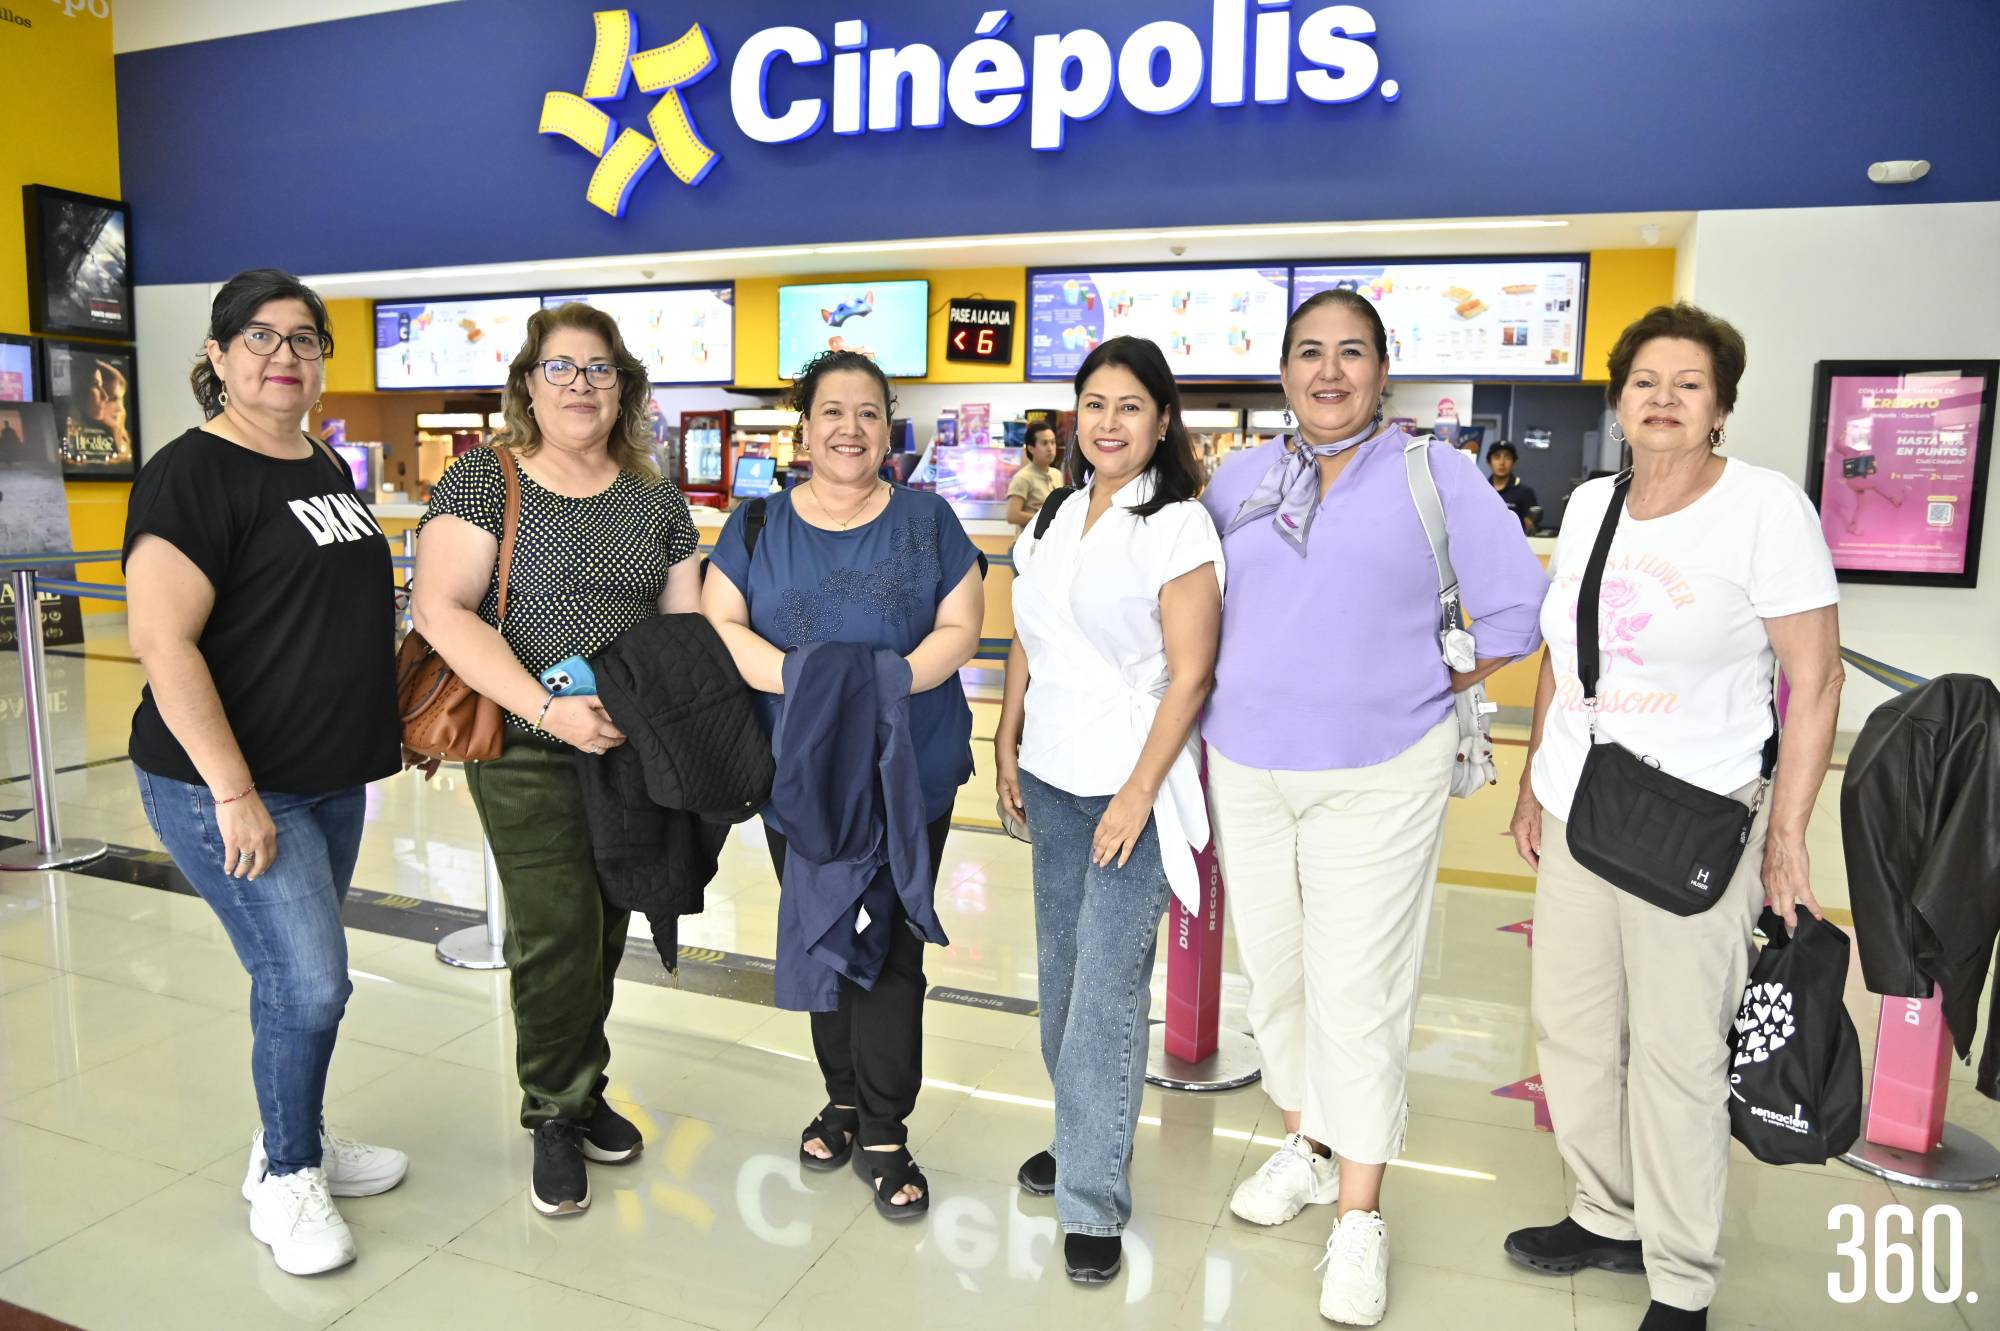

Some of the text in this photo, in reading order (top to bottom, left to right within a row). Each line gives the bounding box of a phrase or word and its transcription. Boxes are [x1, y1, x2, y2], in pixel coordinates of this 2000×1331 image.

[0, 8, 32, 28] llos
[950, 308, 1010, 325] PASE A LA CAJA
[977, 329, 993, 354] 6
[1896, 436, 1937, 446] HASTA
[1896, 447, 1967, 457] EN PUNTOS
[288, 494, 383, 547] DKNY
[1634, 554, 1697, 610] FLOWER
[1556, 676, 1681, 714] Blssom
[1697, 869, 1709, 882] H
[1691, 880, 1708, 890] HUSER
[1209, 864, 1218, 930] RECOGE
[939, 991, 1005, 1007] cinépolis
